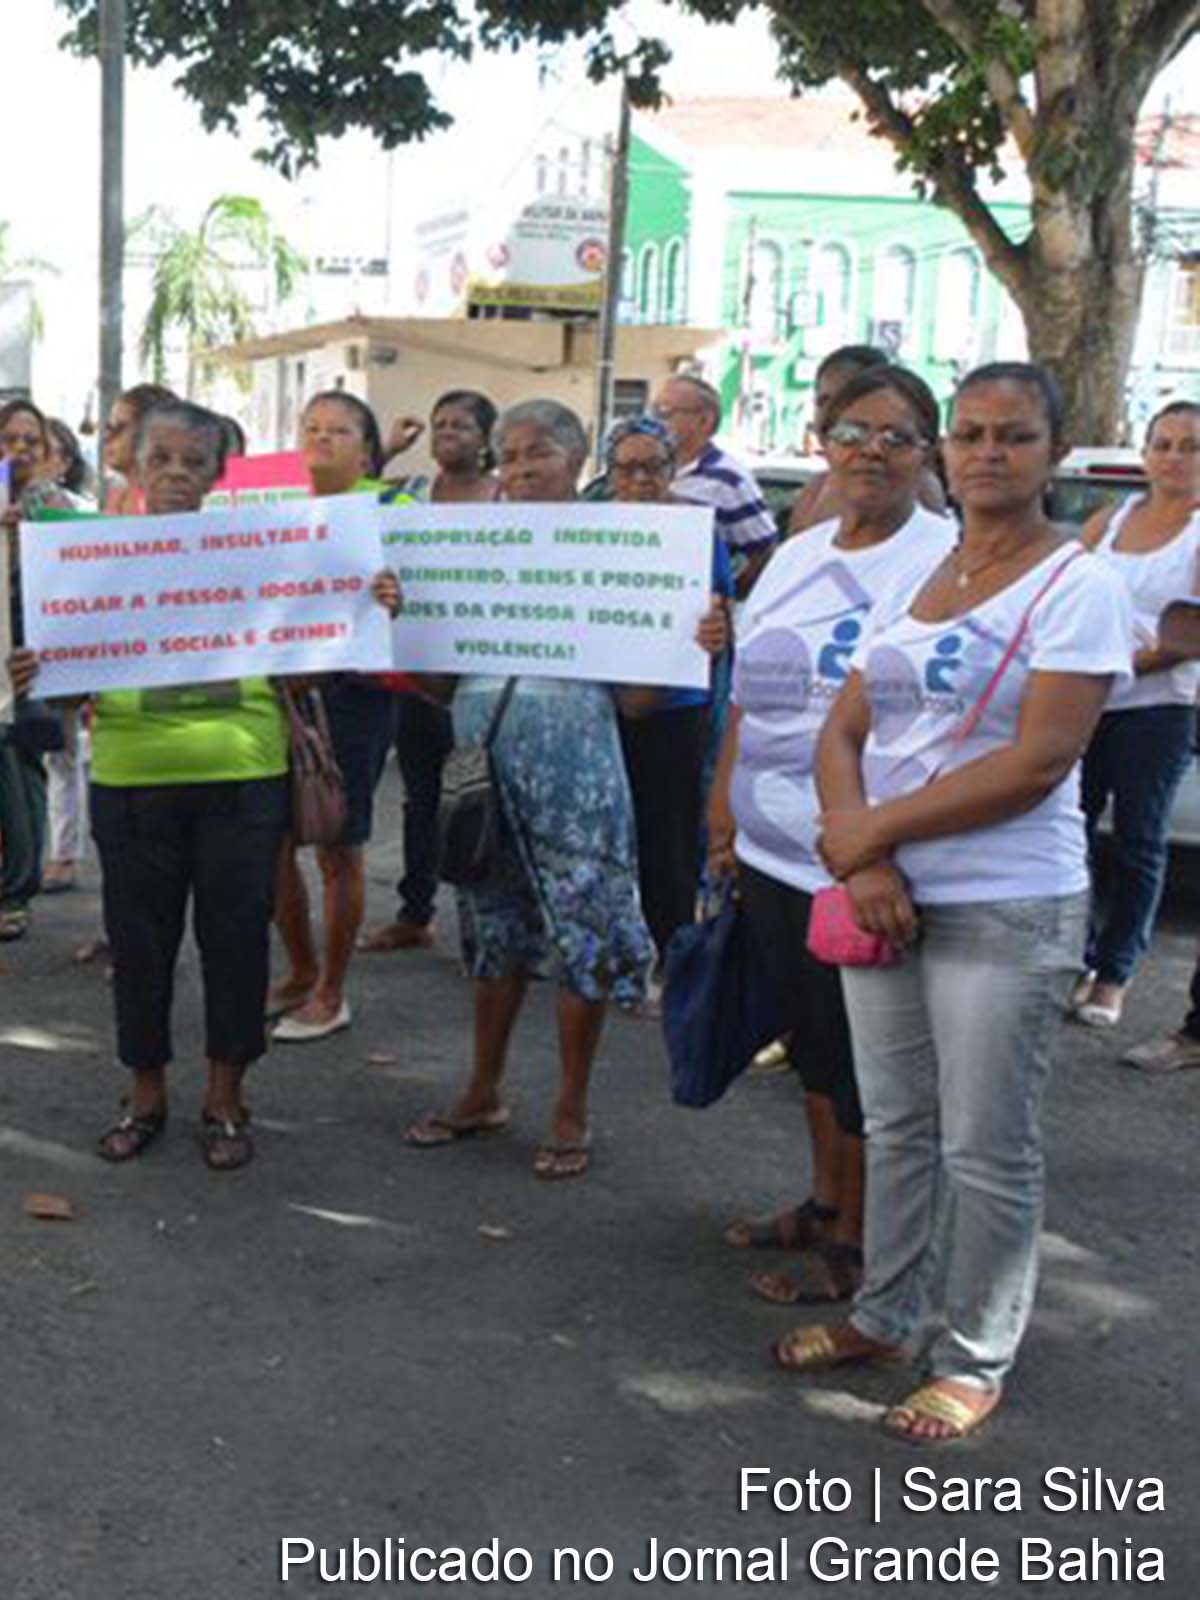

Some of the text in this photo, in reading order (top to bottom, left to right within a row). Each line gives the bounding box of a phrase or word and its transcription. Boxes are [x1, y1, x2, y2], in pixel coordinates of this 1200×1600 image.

[60, 539, 189, 561] HUMILHAR,
[201, 526, 309, 549] INSULTAR
[554, 528, 662, 547] INDEVIDA
[519, 569, 576, 586] BENS
[582, 570, 595, 586] E
[42, 597, 122, 616] ISOLAR
[131, 595, 146, 610] A
[158, 587, 245, 606] PESSOA
[331, 576, 363, 591] DO
[454, 602, 486, 619] DA
[491, 603, 575, 621] PESSOA
[589, 607, 655, 628] IDOSA
[160, 635, 237, 655] SOCIAL
